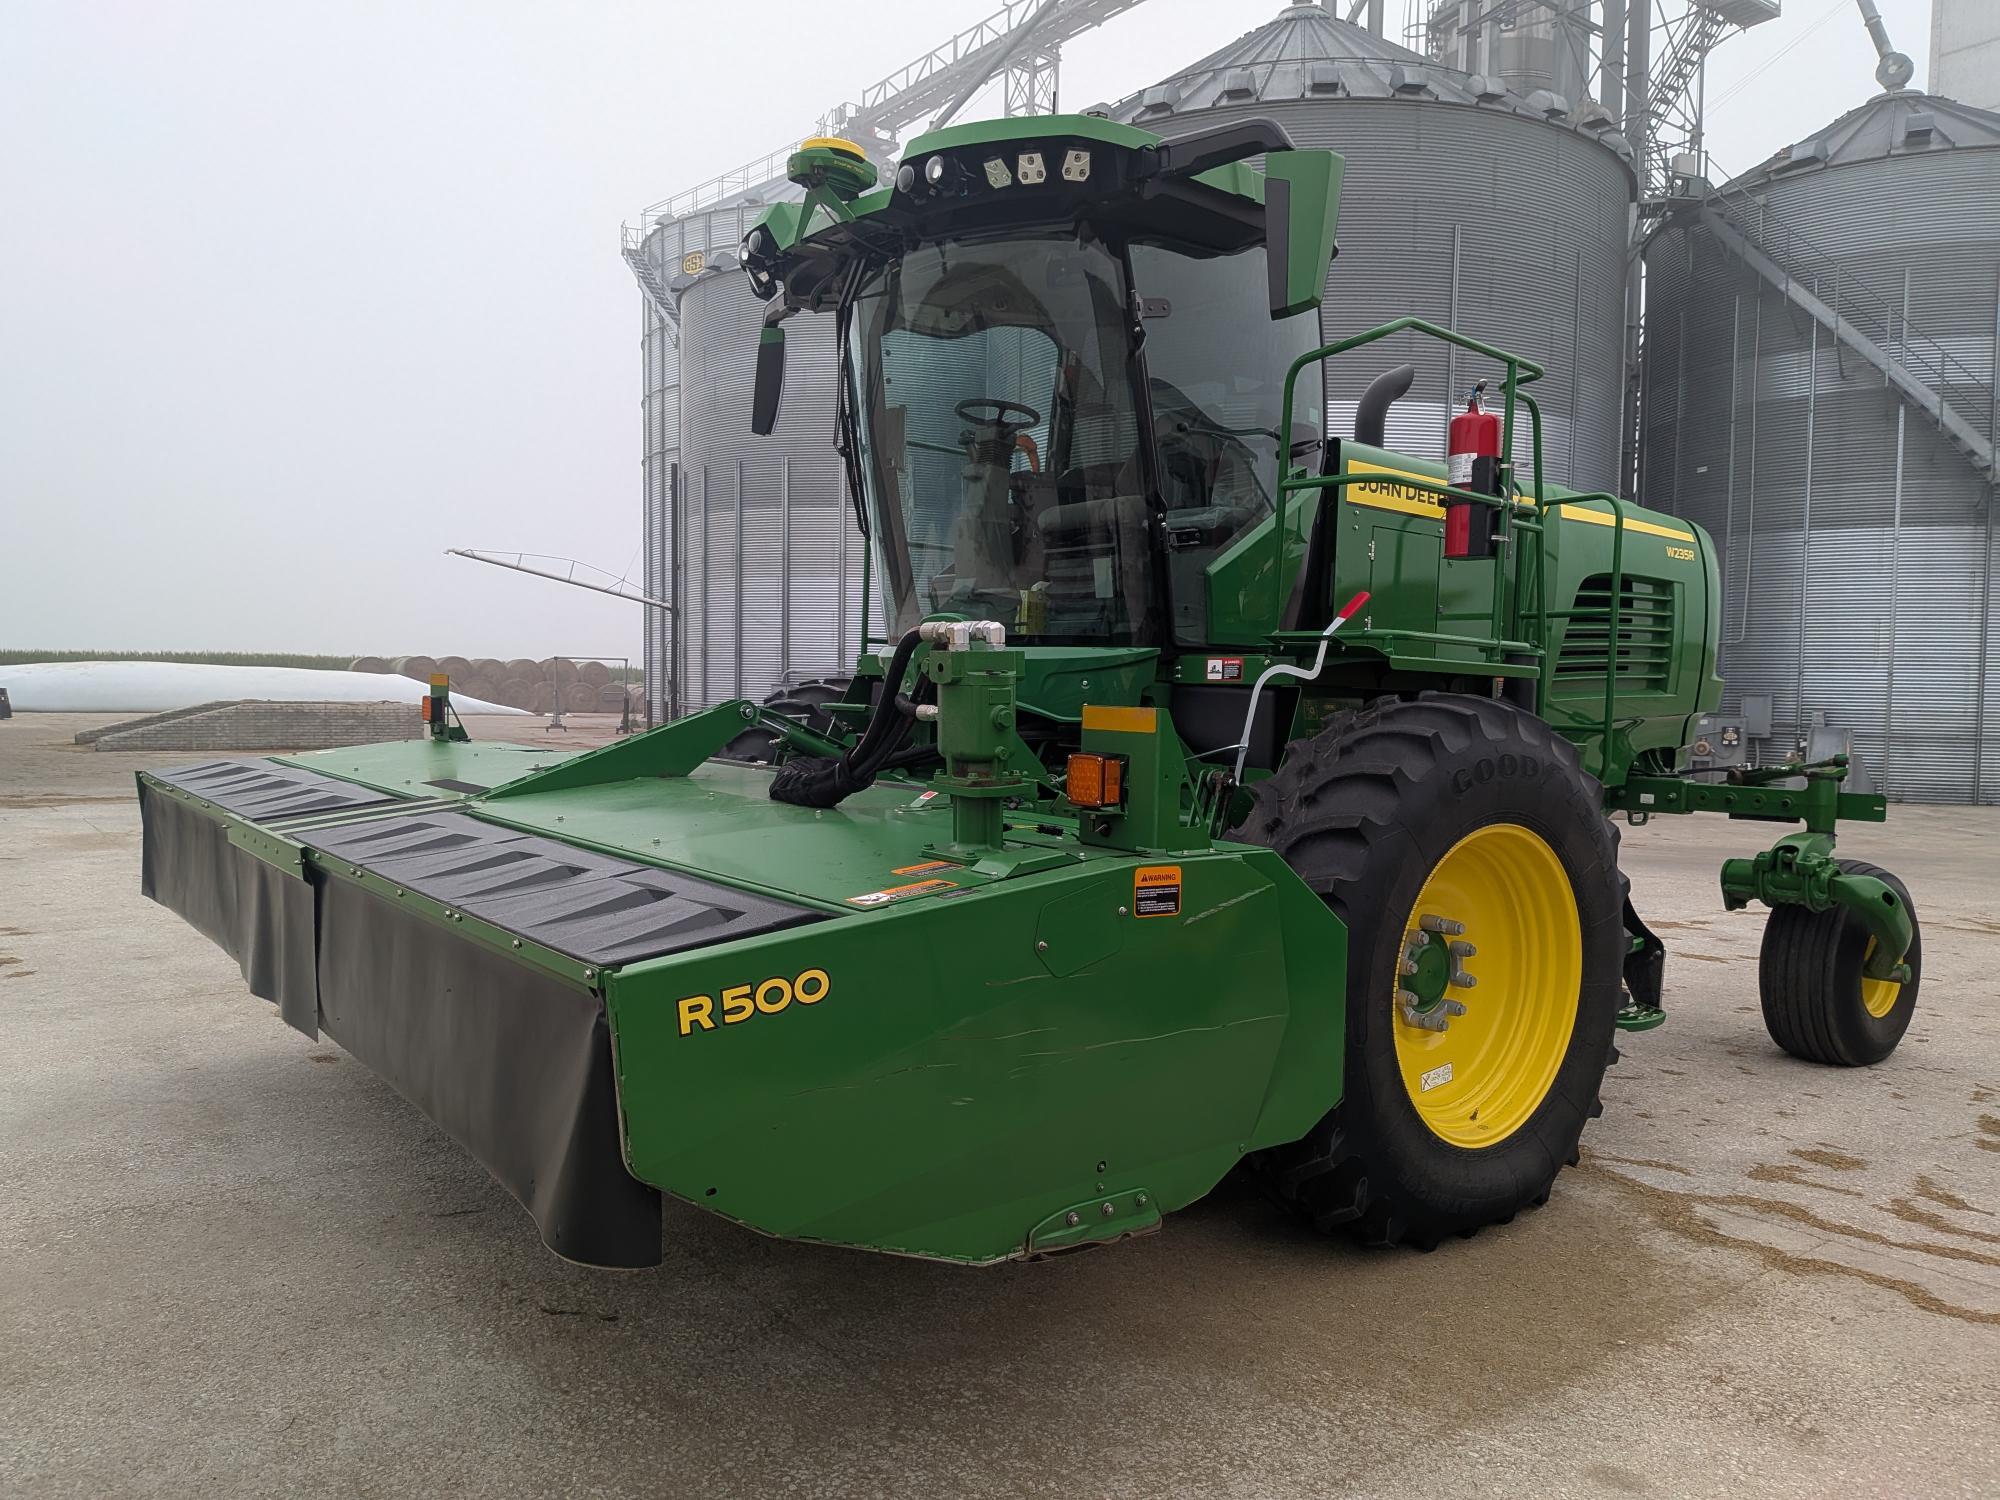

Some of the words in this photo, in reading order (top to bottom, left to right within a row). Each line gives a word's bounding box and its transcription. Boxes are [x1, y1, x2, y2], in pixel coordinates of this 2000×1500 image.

[1358, 482, 1402, 499] JOHN
[1406, 485, 1448, 507] DEE
[1147, 874, 1176, 882] WARNING
